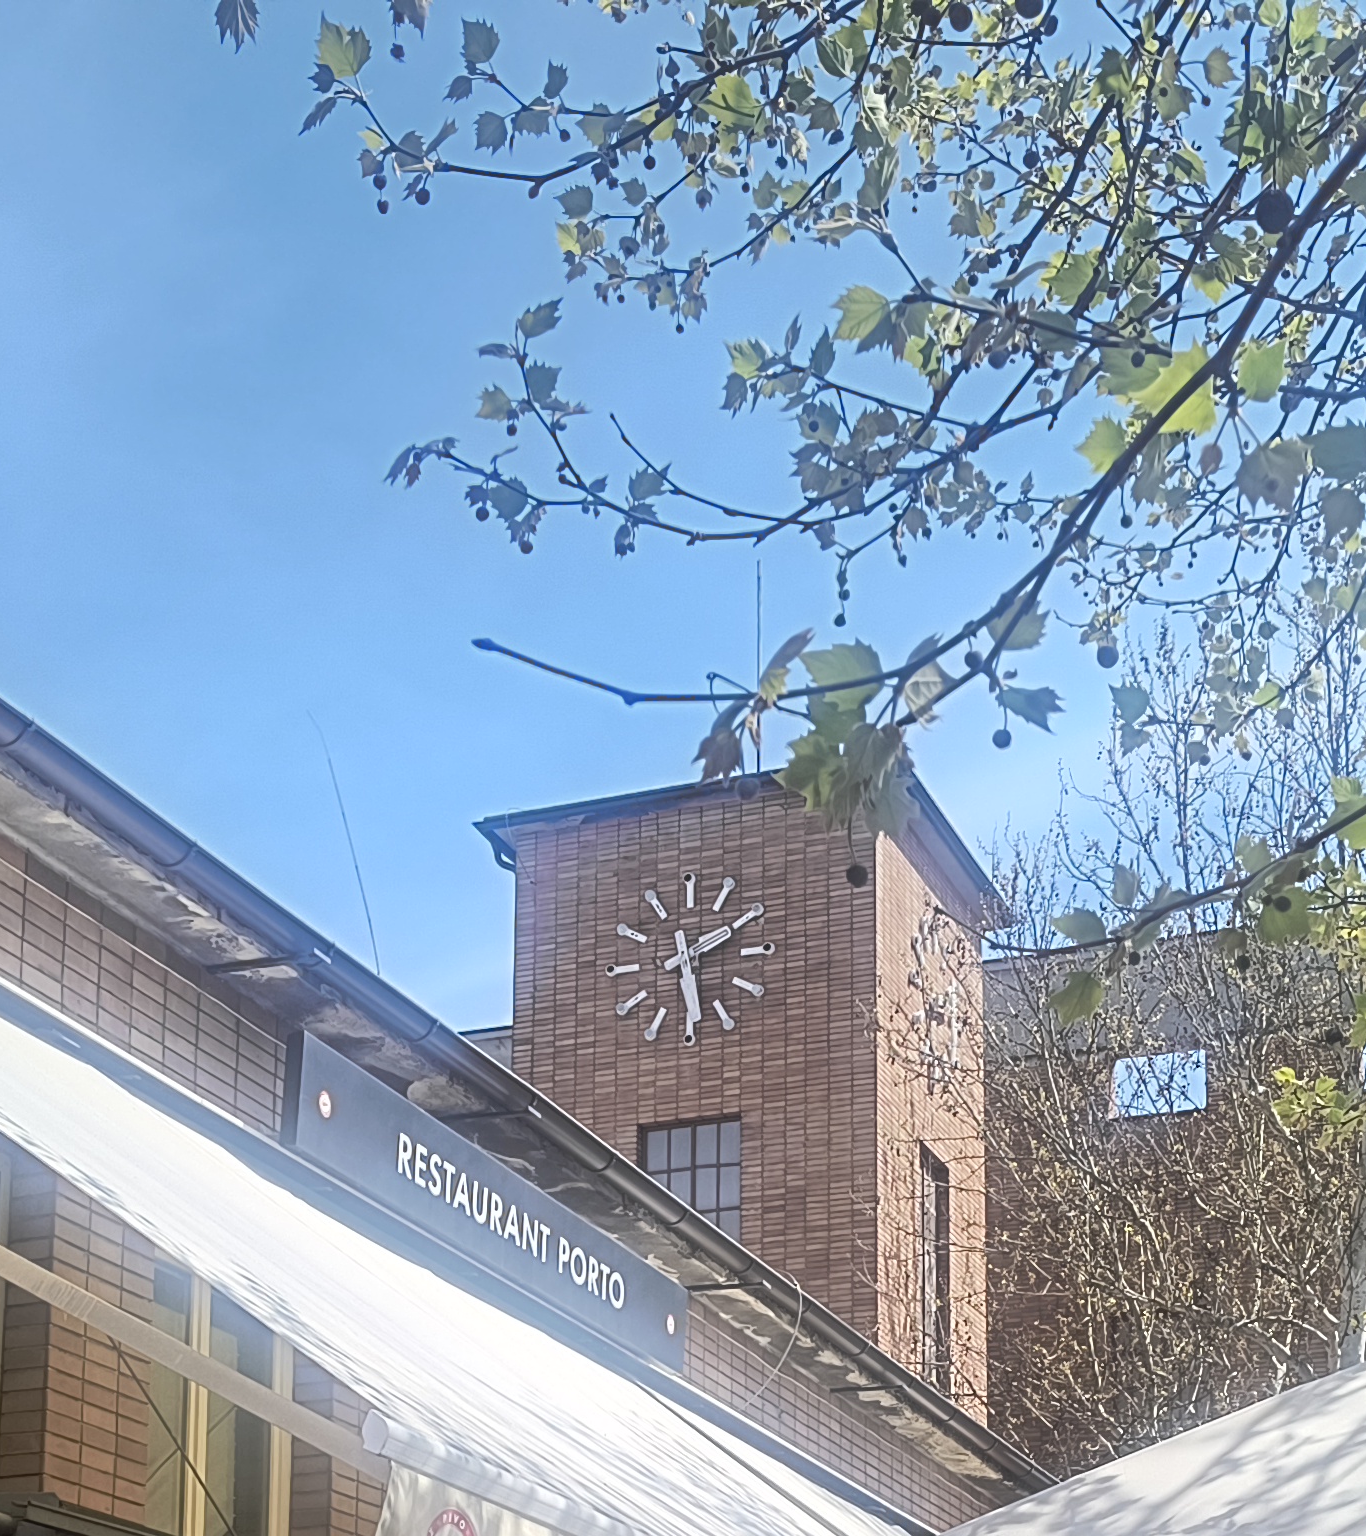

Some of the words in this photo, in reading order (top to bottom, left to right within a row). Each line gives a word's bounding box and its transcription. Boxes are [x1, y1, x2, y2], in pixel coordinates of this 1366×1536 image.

[396, 1131, 552, 1263] RESTAURANT
[557, 1236, 626, 1310] PORTO
[442, 1513, 466, 1530] PIVO
